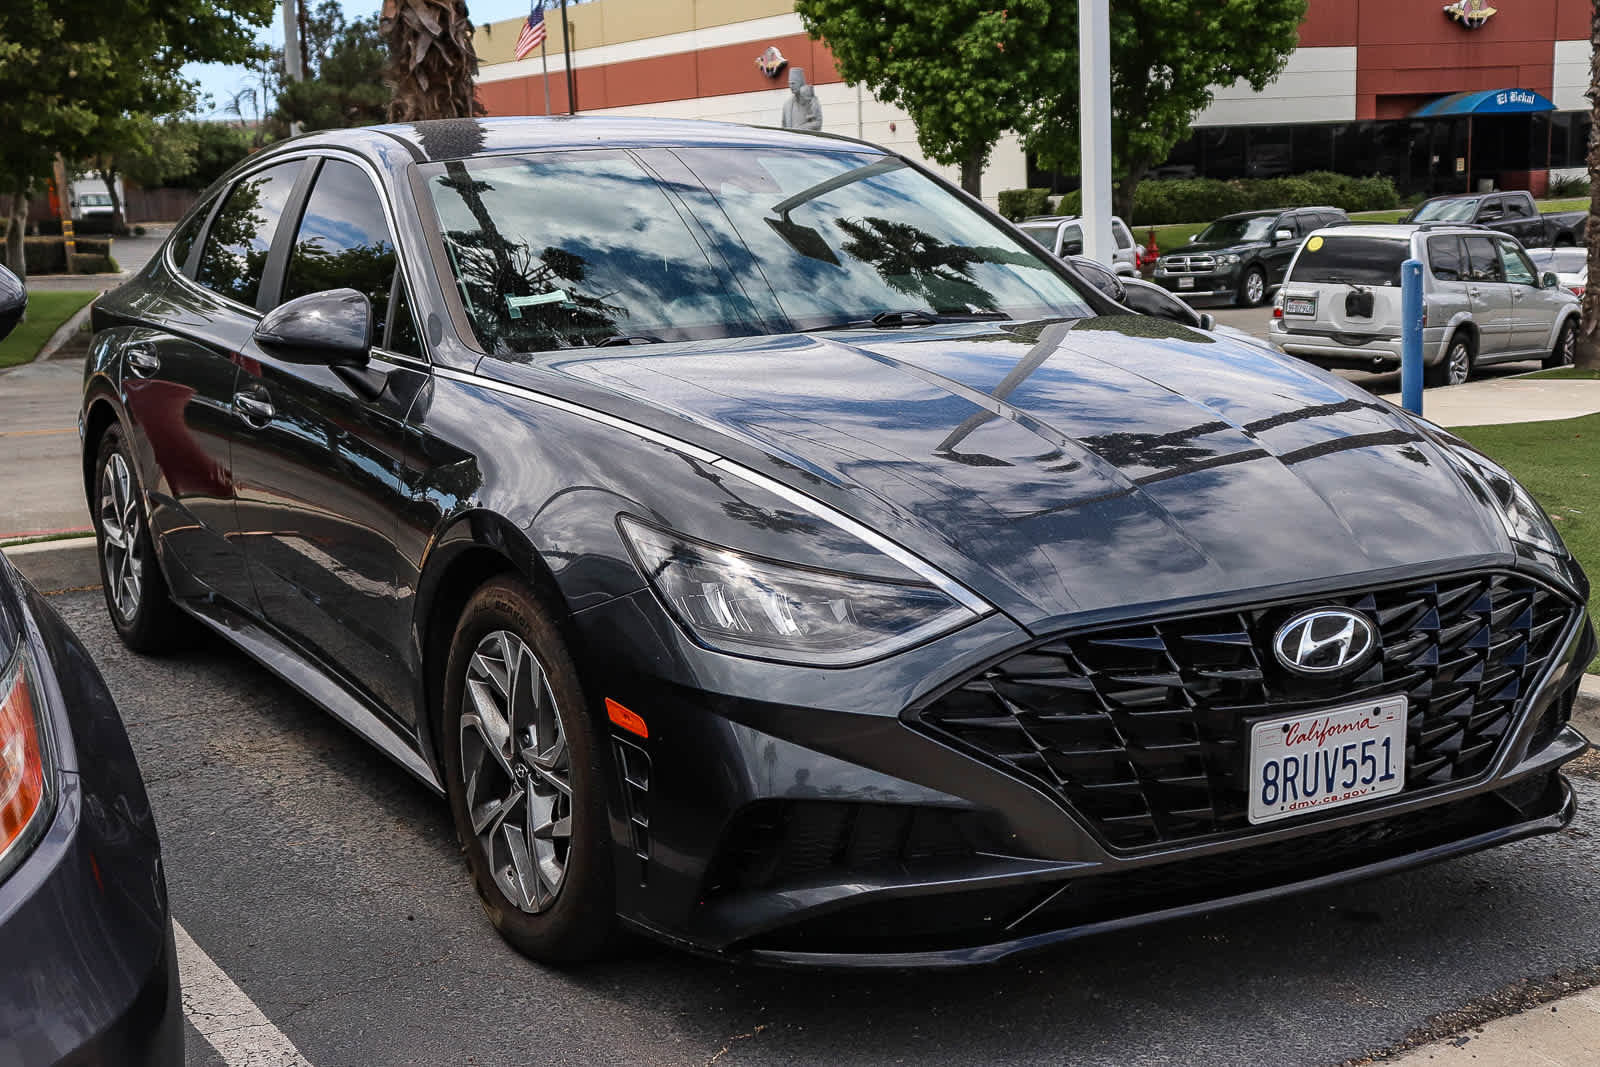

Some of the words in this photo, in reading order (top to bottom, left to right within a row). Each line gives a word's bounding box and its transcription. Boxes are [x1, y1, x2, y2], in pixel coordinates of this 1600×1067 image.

[1496, 92, 1508, 104] El
[1285, 713, 1380, 747] California
[1262, 736, 1395, 806] 8RUV551
[1289, 788, 1368, 811] dmv.ca.gov
